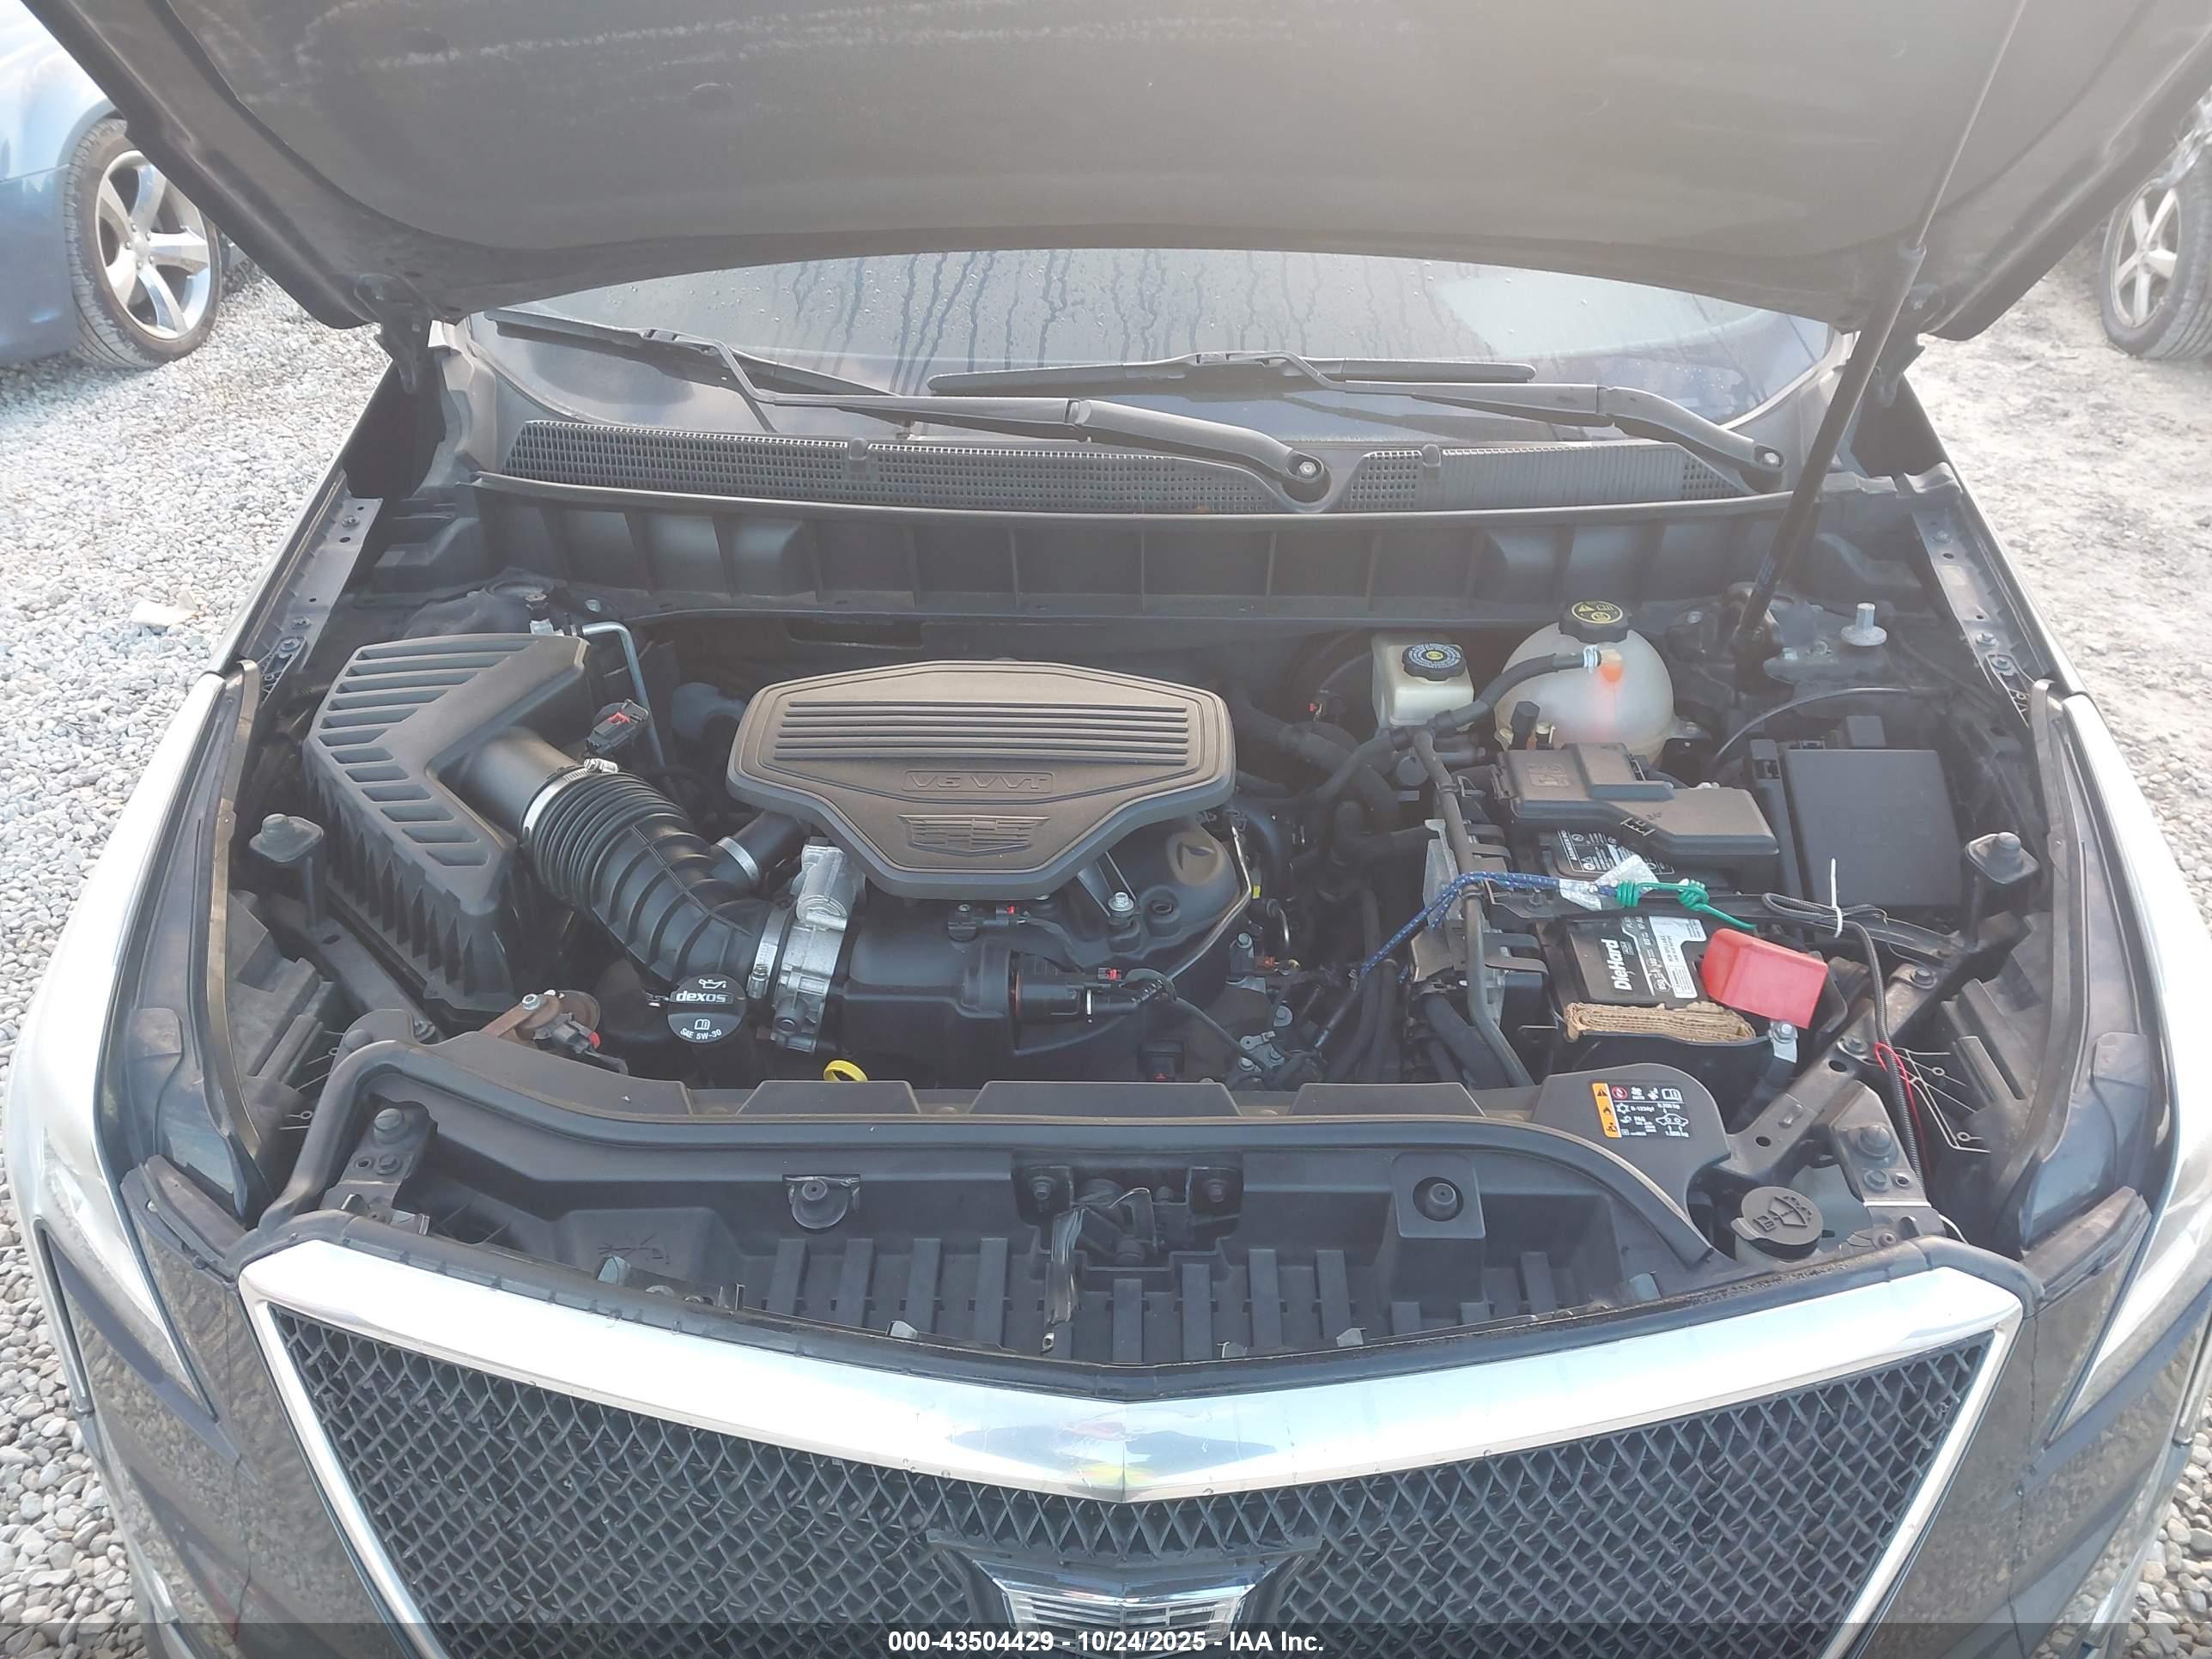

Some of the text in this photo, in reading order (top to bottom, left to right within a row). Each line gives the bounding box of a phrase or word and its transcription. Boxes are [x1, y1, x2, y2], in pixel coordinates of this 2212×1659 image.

[910, 775, 1048, 790] V6 VVT
[1600, 938, 1636, 991] DieHard
[676, 990, 729, 1003] dexos
[679, 1028, 722, 1040] SAE 5W-30
